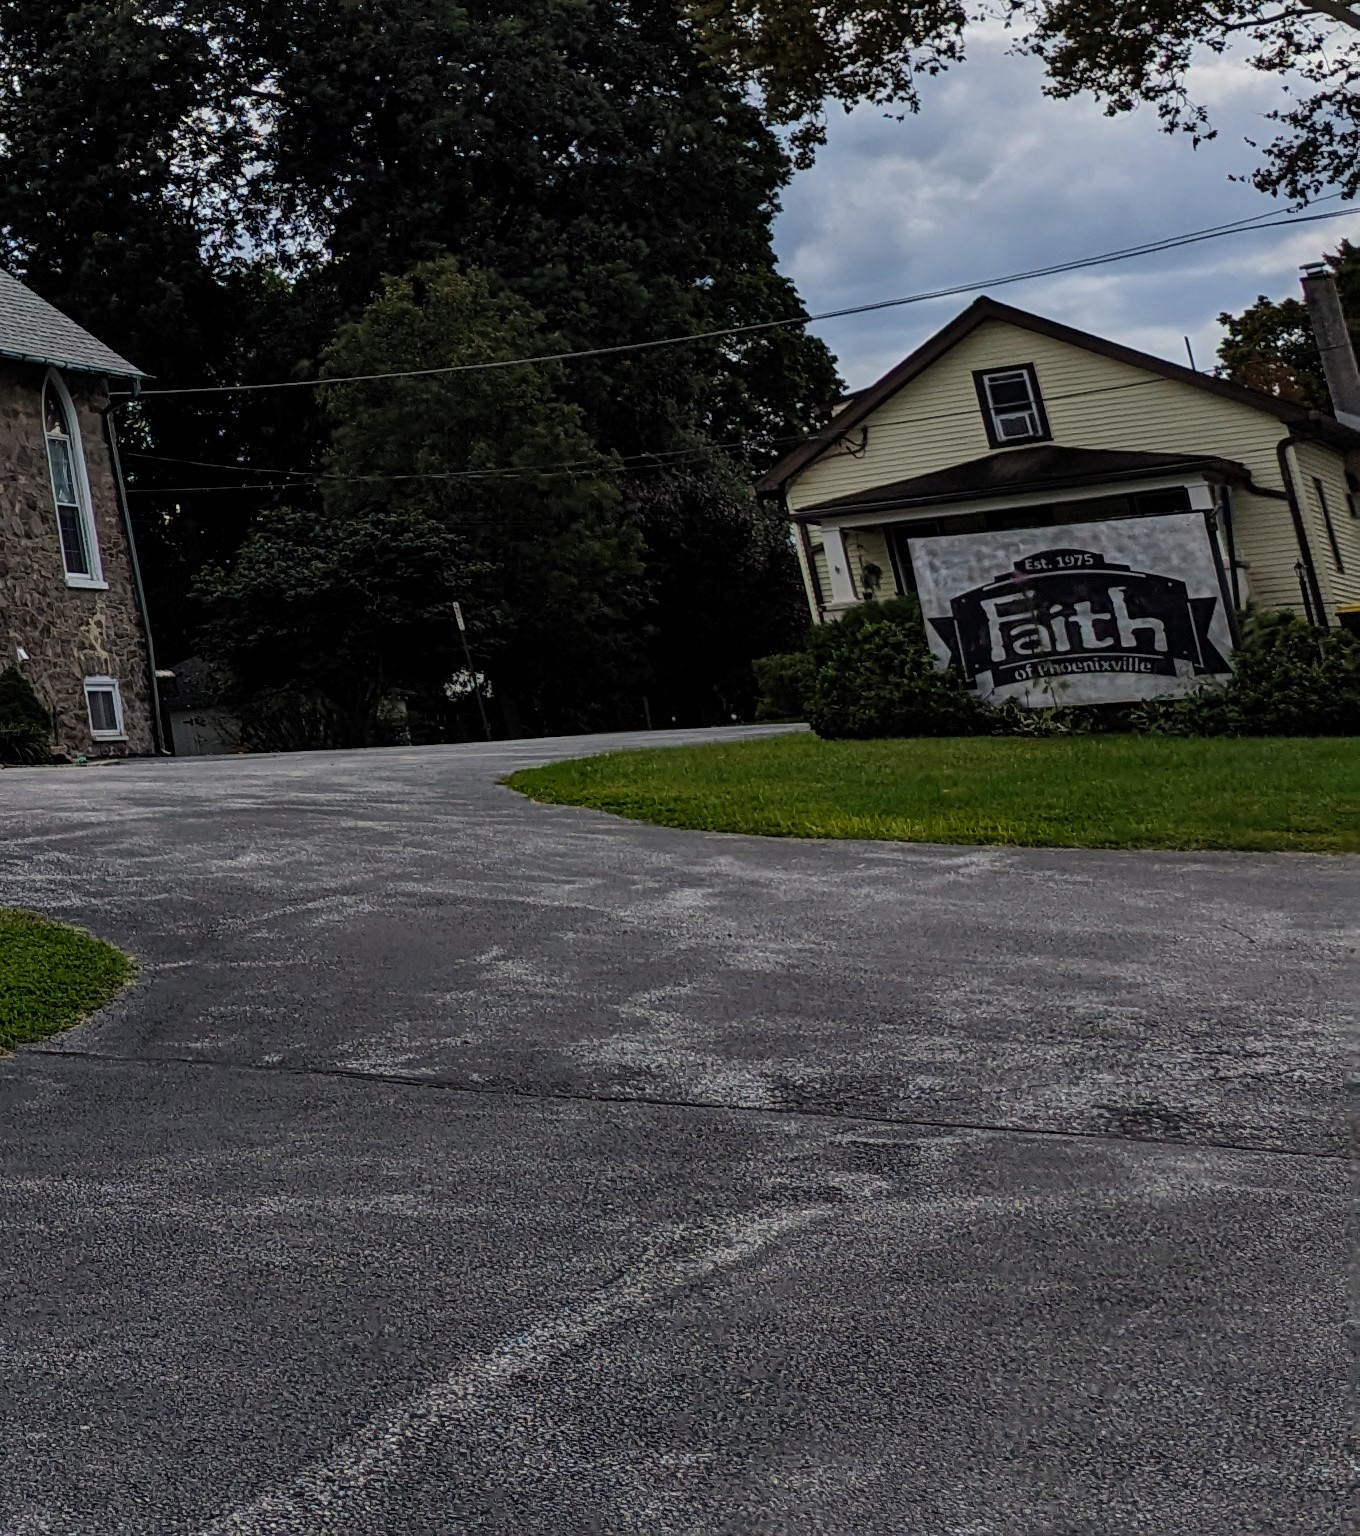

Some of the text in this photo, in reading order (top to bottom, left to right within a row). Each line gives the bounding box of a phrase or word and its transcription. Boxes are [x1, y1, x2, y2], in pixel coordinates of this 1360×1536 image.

[1024, 554, 1094, 570] Est. 1975
[980, 586, 1168, 662] Faith
[1014, 657, 1152, 680] of Phoenixville
